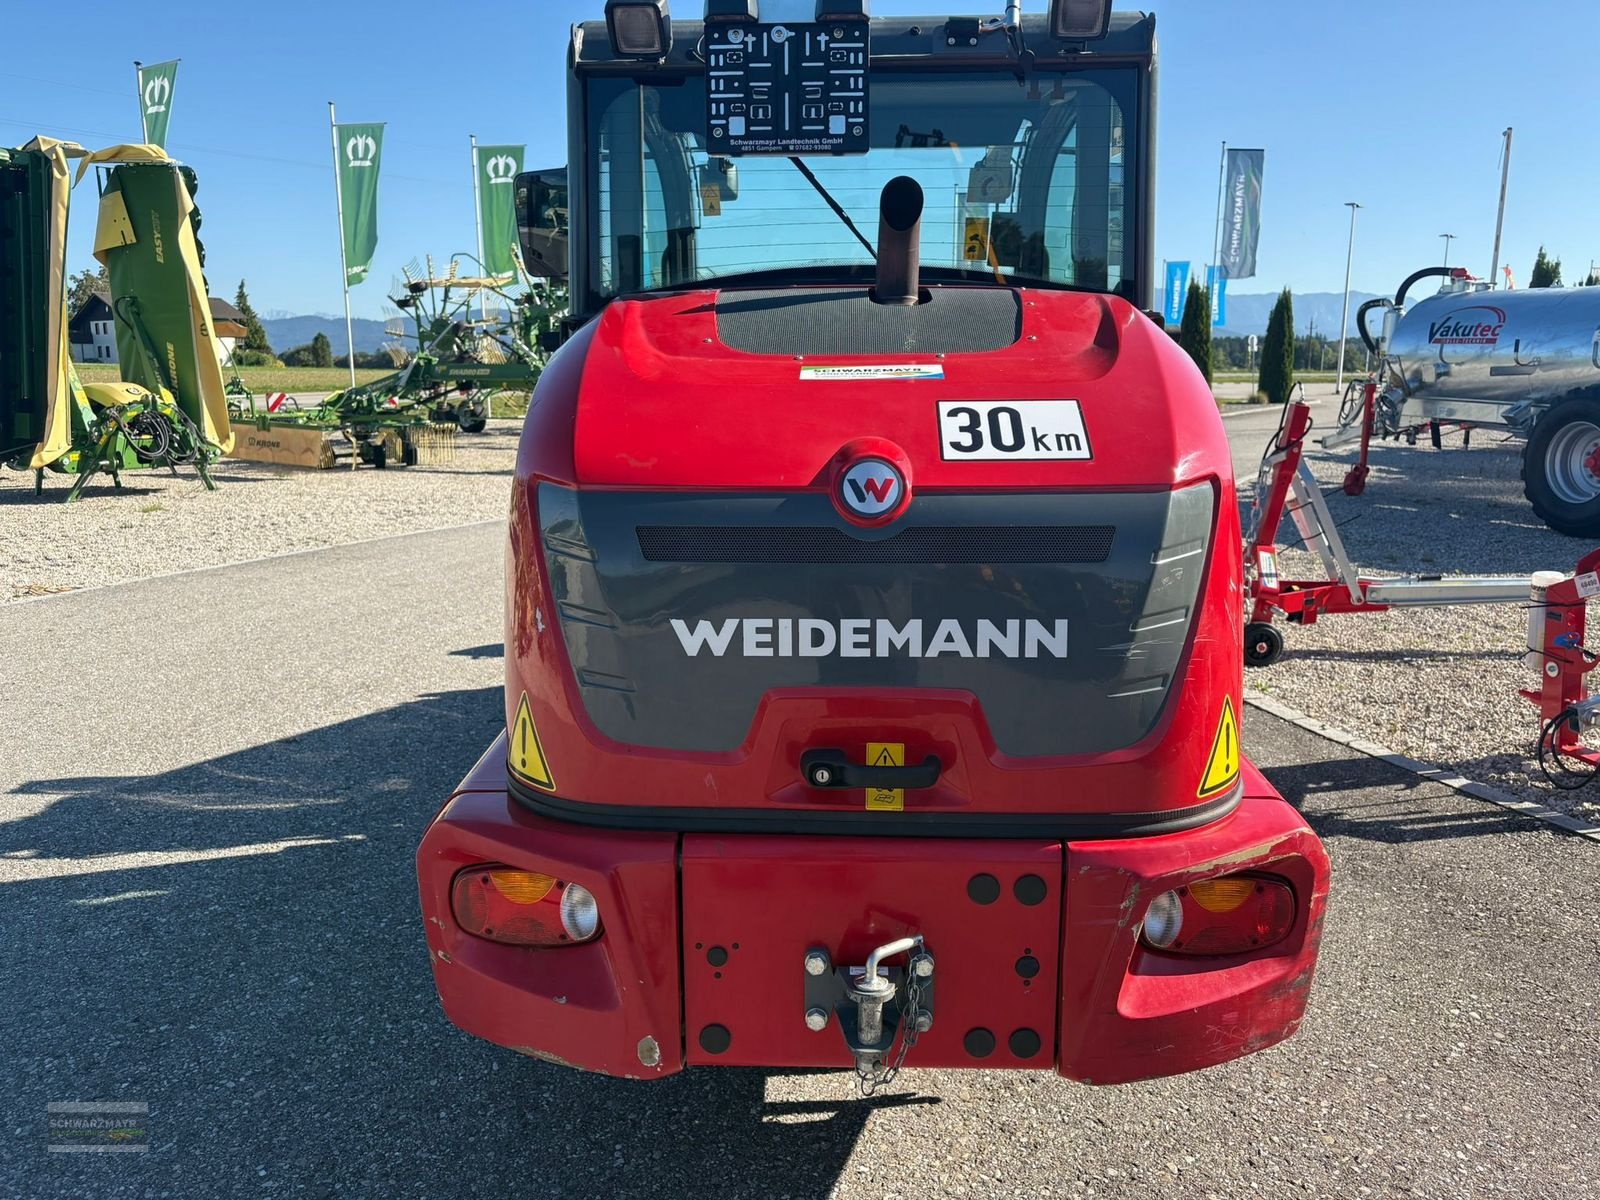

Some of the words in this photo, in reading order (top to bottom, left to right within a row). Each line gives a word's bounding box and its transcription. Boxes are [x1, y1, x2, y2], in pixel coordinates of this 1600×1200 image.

[1230, 175, 1246, 262] SCHWARZMAYR
[1428, 316, 1503, 343] Vakutec
[256, 440, 281, 448] KRONE
[947, 406, 1025, 453] 30
[1031, 426, 1082, 452] km
[670, 618, 1068, 658] WEIDEMANN
